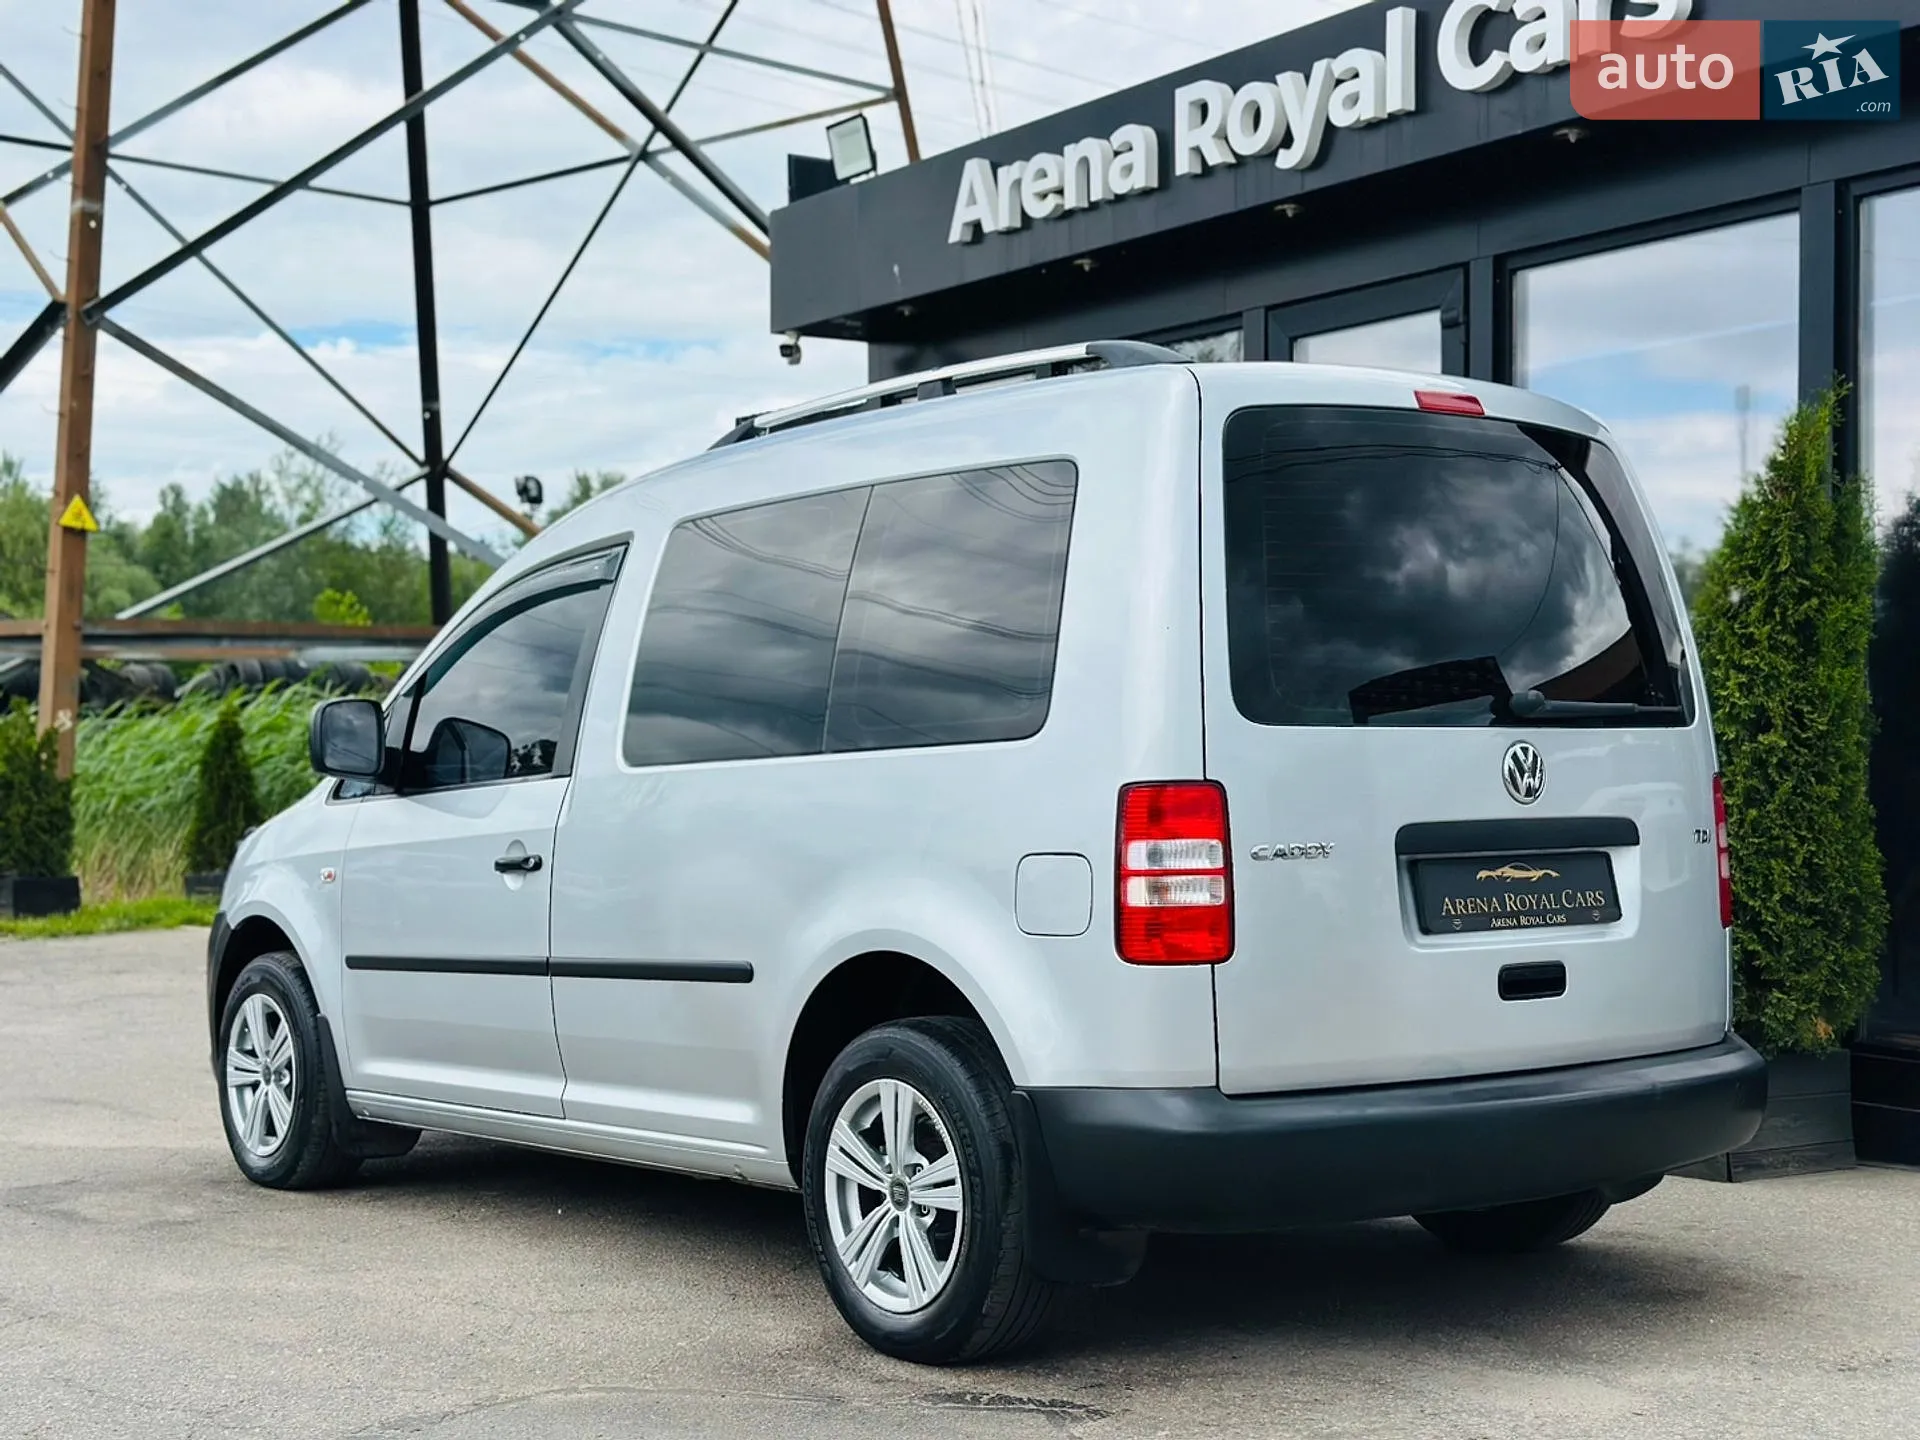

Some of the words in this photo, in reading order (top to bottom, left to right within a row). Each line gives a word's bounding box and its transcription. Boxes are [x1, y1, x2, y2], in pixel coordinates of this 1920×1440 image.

[948, 123, 1159, 244] Arena
[1175, 6, 1416, 177] Royal
[1250, 841, 1335, 861] CADDY
[1441, 896, 1501, 916] ARENA
[1504, 892, 1560, 911] ROYAL
[1562, 889, 1606, 908] CARS
[1491, 916, 1518, 928] ARENA
[1520, 915, 1545, 926] ROYAL
[1546, 913, 1567, 924] CARS
